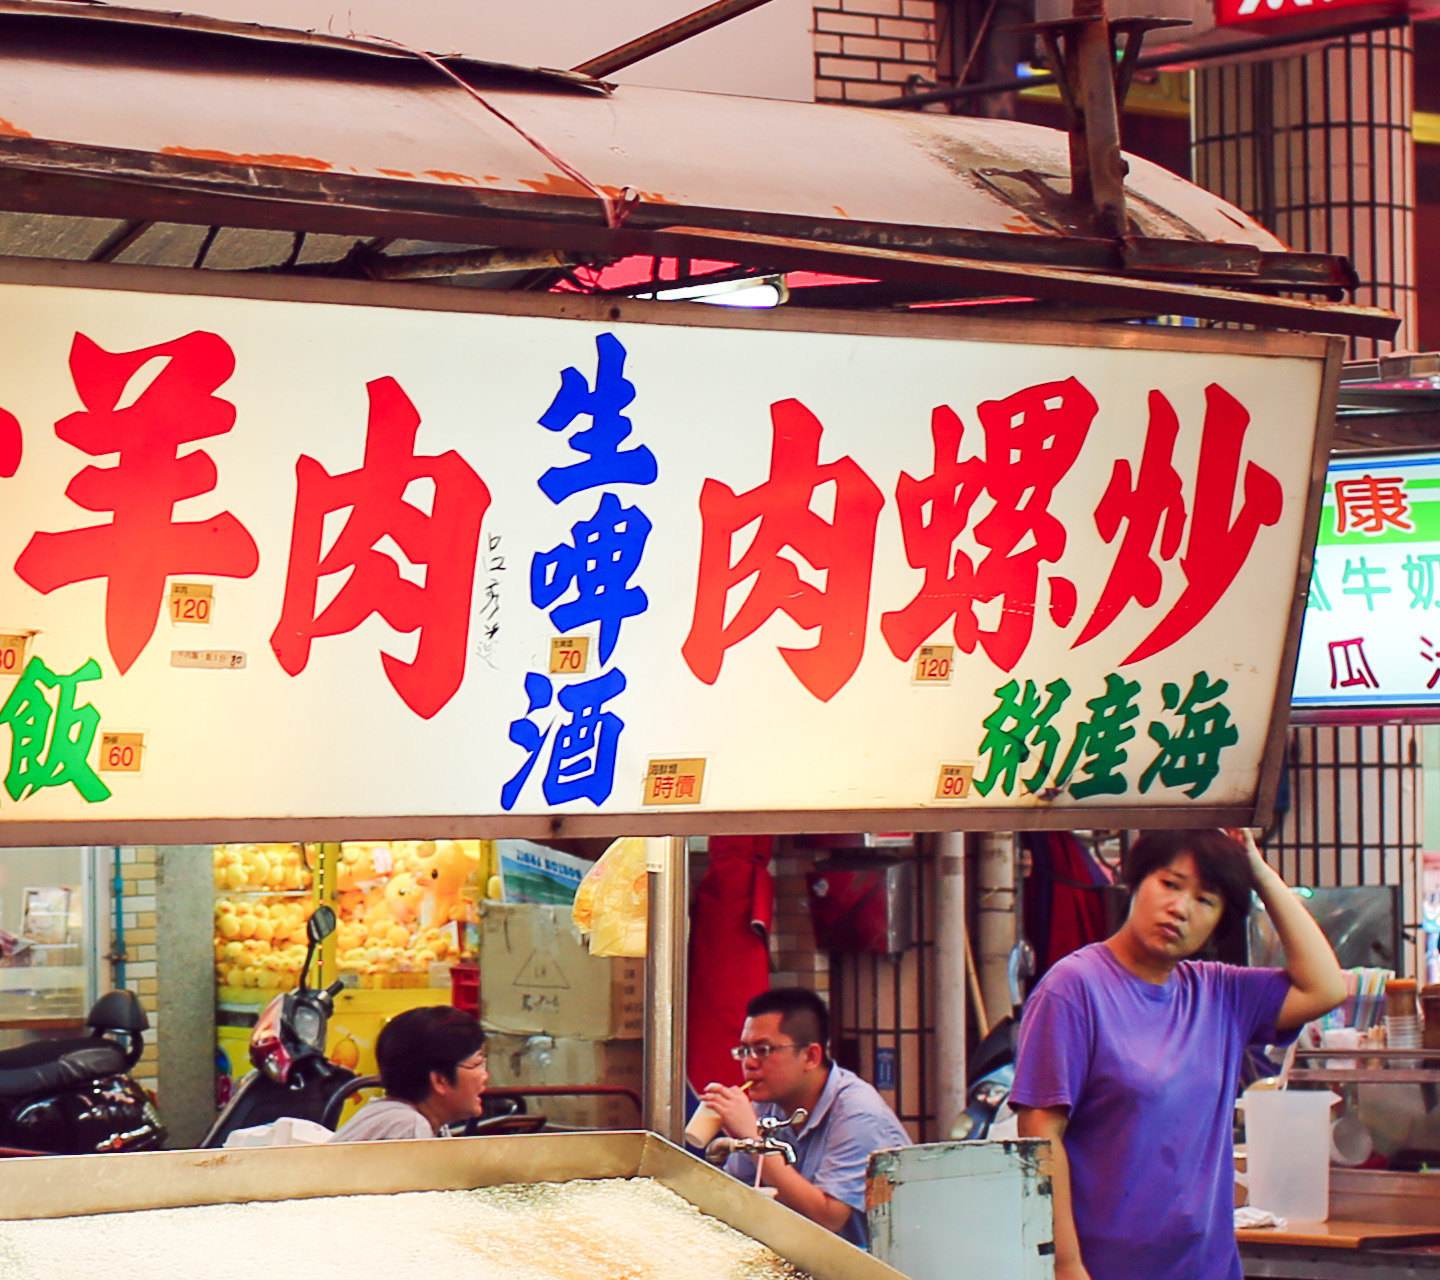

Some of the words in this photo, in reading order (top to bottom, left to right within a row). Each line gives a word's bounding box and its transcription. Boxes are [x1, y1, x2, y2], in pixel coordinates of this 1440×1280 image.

[500, 332, 659, 812] 生啤酒
[172, 598, 209, 620] 120
[559, 650, 582, 670] 70
[920, 658, 949, 677] 120
[108, 745, 134, 767] 60
[653, 774, 696, 799] 時價
[943, 776, 964, 796] 90
